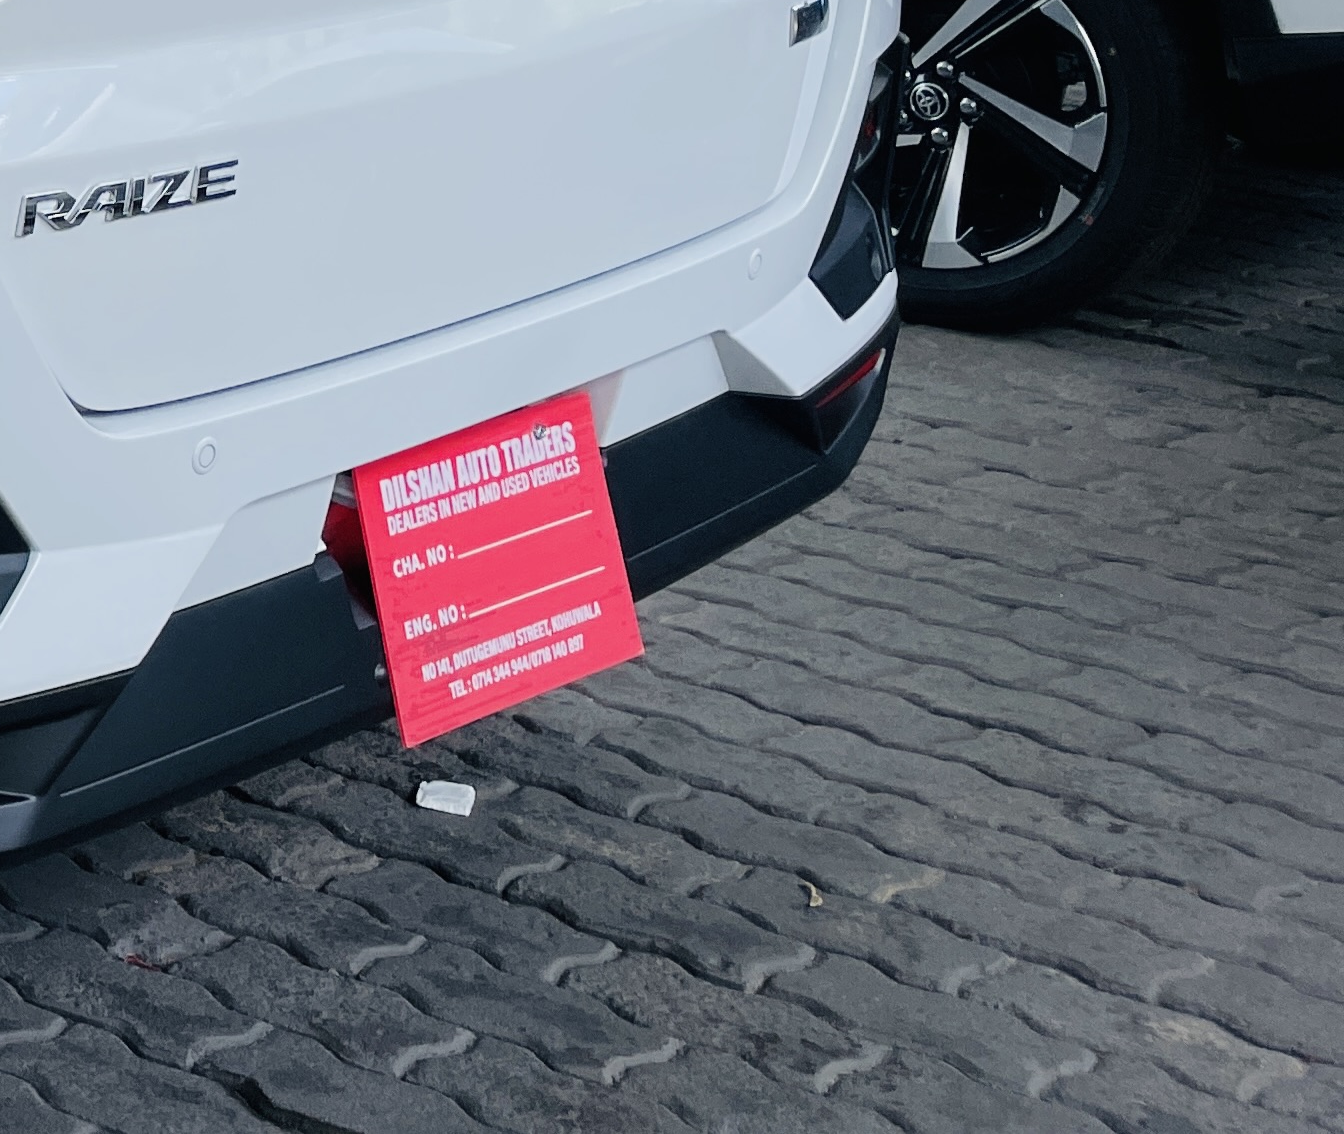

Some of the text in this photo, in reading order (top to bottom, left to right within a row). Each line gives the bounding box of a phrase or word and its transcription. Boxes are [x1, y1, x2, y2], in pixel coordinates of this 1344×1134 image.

[14, 159, 240, 238] RAIZE
[379, 421, 576, 513] DILSHAN AUTO TRADERS
[386, 455, 581, 537] DEALERS IN NEW AND USED VEHICLES
[392, 557, 426, 578] CHA.
[403, 614, 438, 640] ENG.
[421, 662, 438, 683] NO
[550, 600, 602, 634] KOHUWALA
